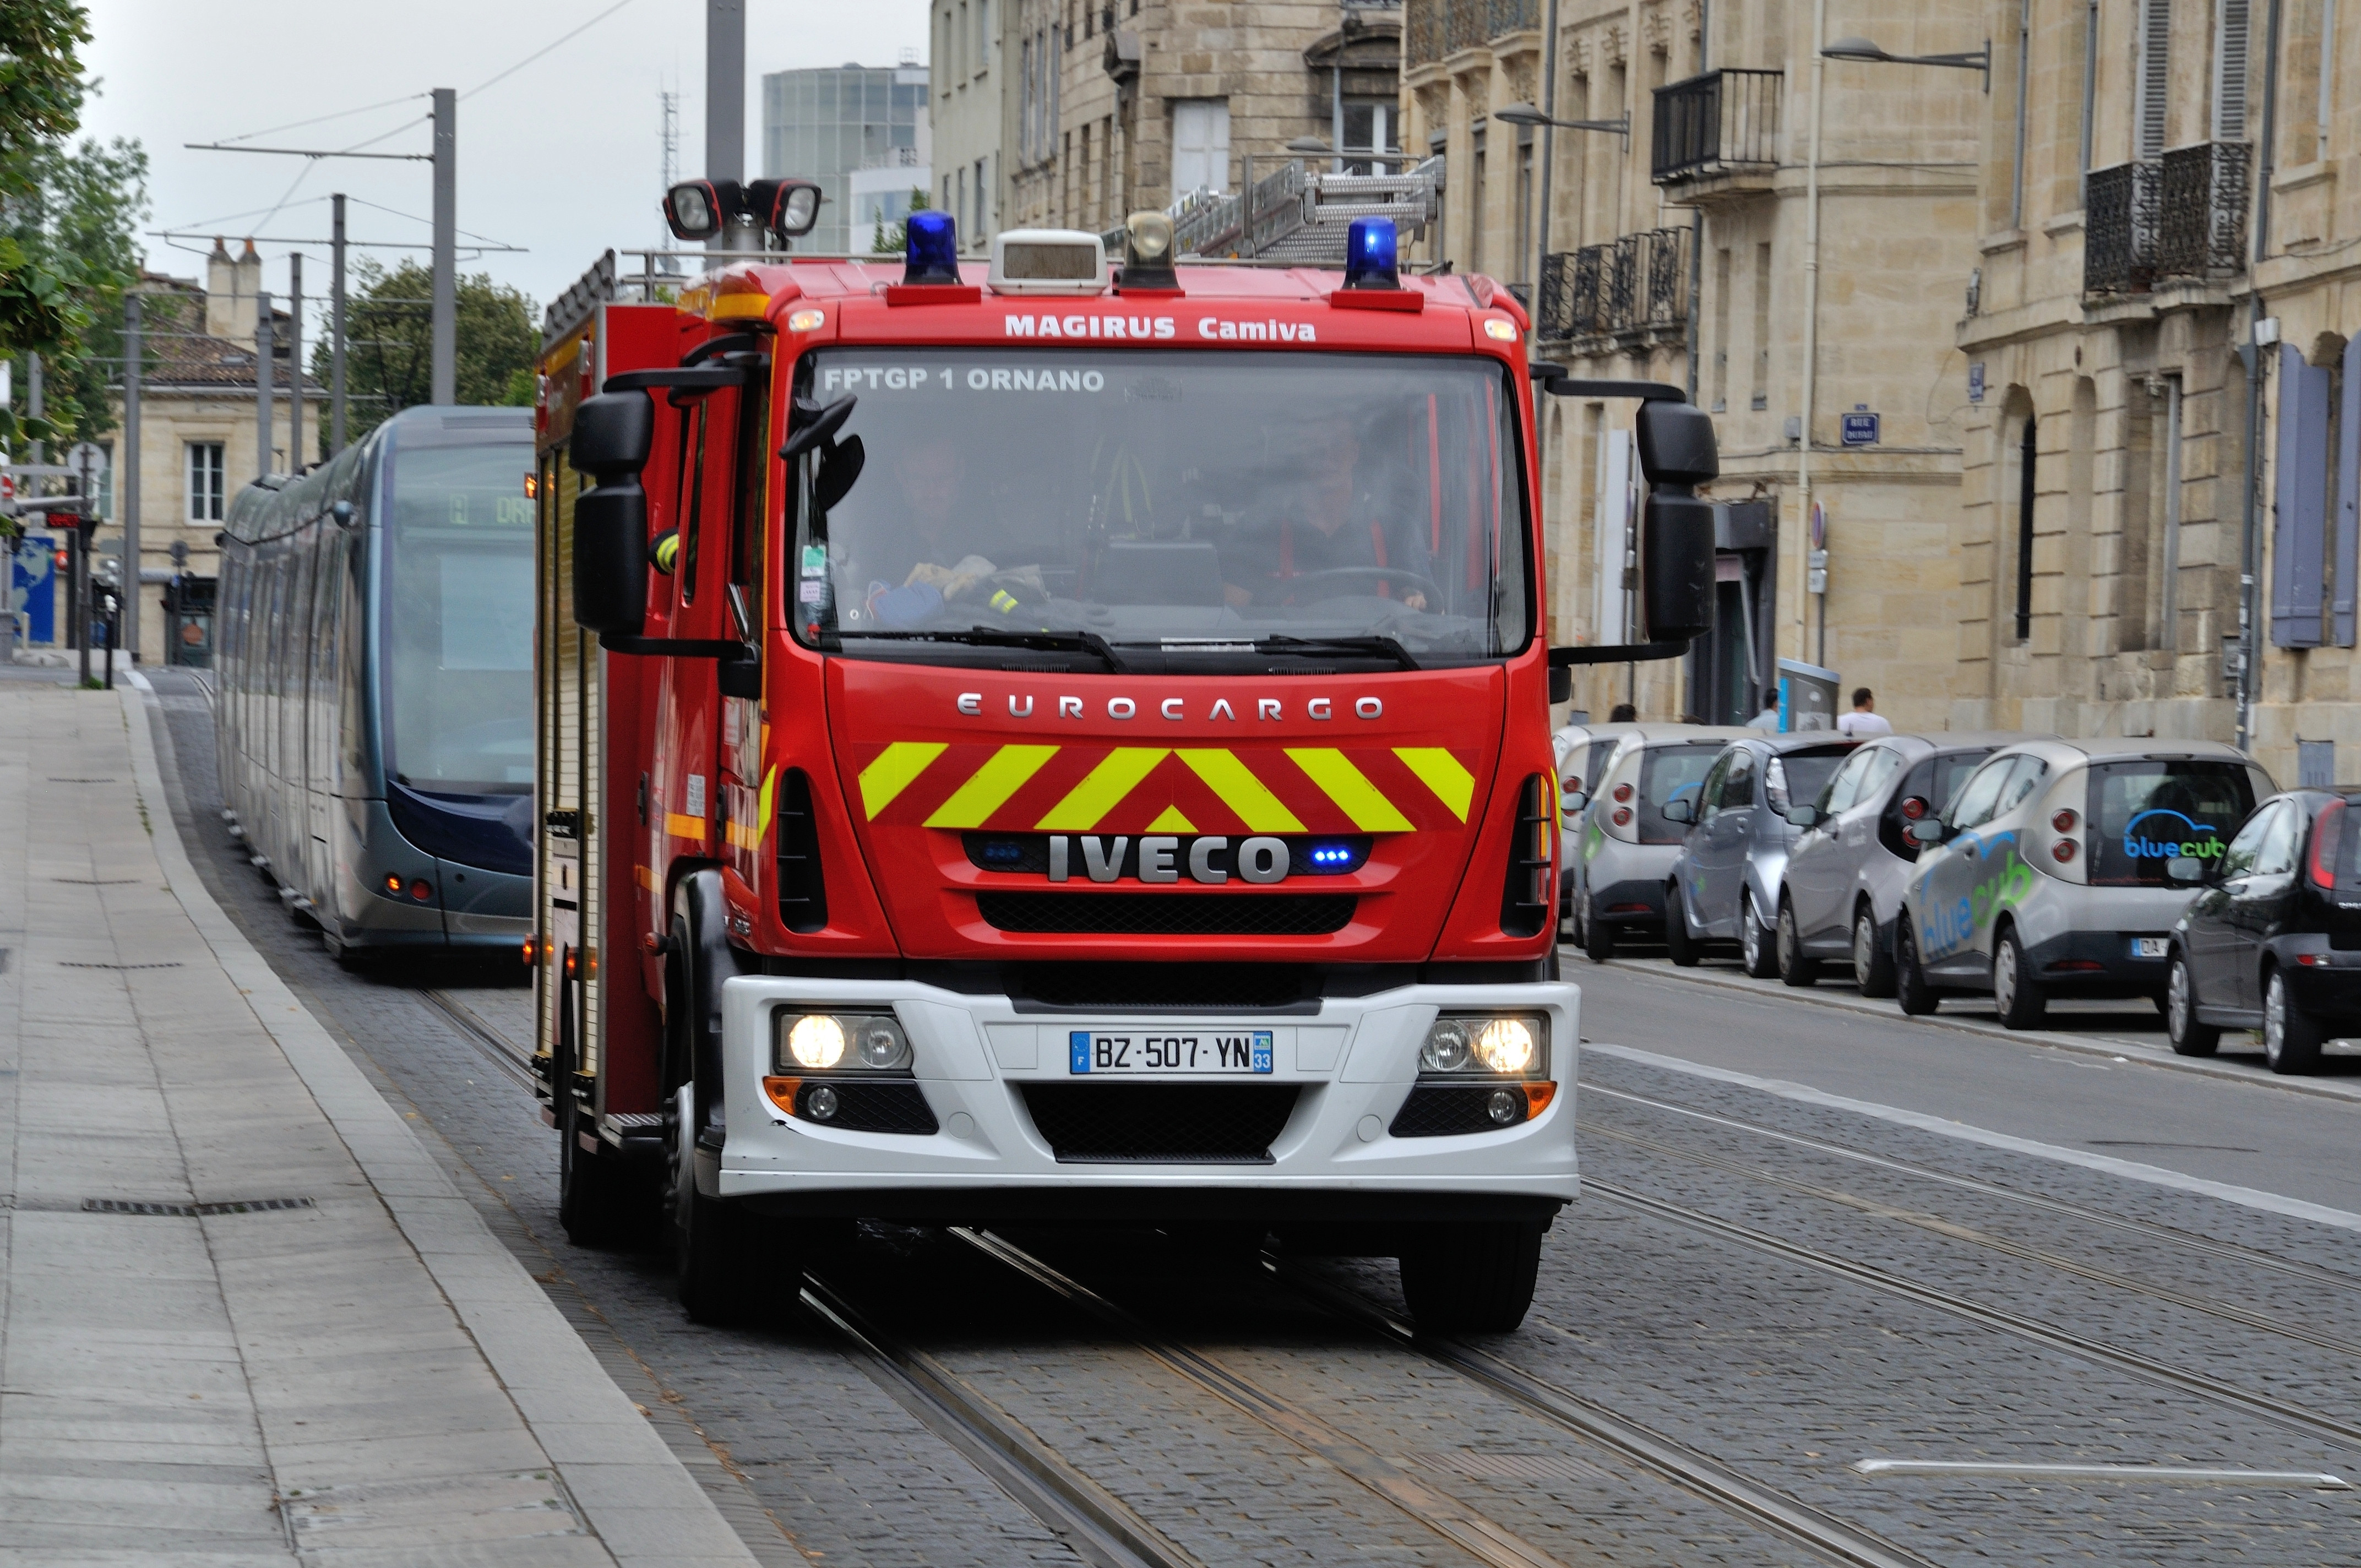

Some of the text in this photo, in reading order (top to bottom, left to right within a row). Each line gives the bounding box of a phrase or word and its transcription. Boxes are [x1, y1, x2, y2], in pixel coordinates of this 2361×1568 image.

[1005, 314, 1316, 342] MAGIRUS Camiva
[824, 368, 927, 390] FPTGP
[939, 368, 953, 389] 1
[967, 368, 1105, 391] ORNANO
[1851, 418, 1871, 427] RUE
[957, 693, 1383, 721] EUROCARGO
[2124, 836, 2227, 858] bluecub
[1048, 835, 1290, 884] IVECO
[1077, 1057, 1084, 1066] F
[1254, 1053, 1271, 1069] 33
